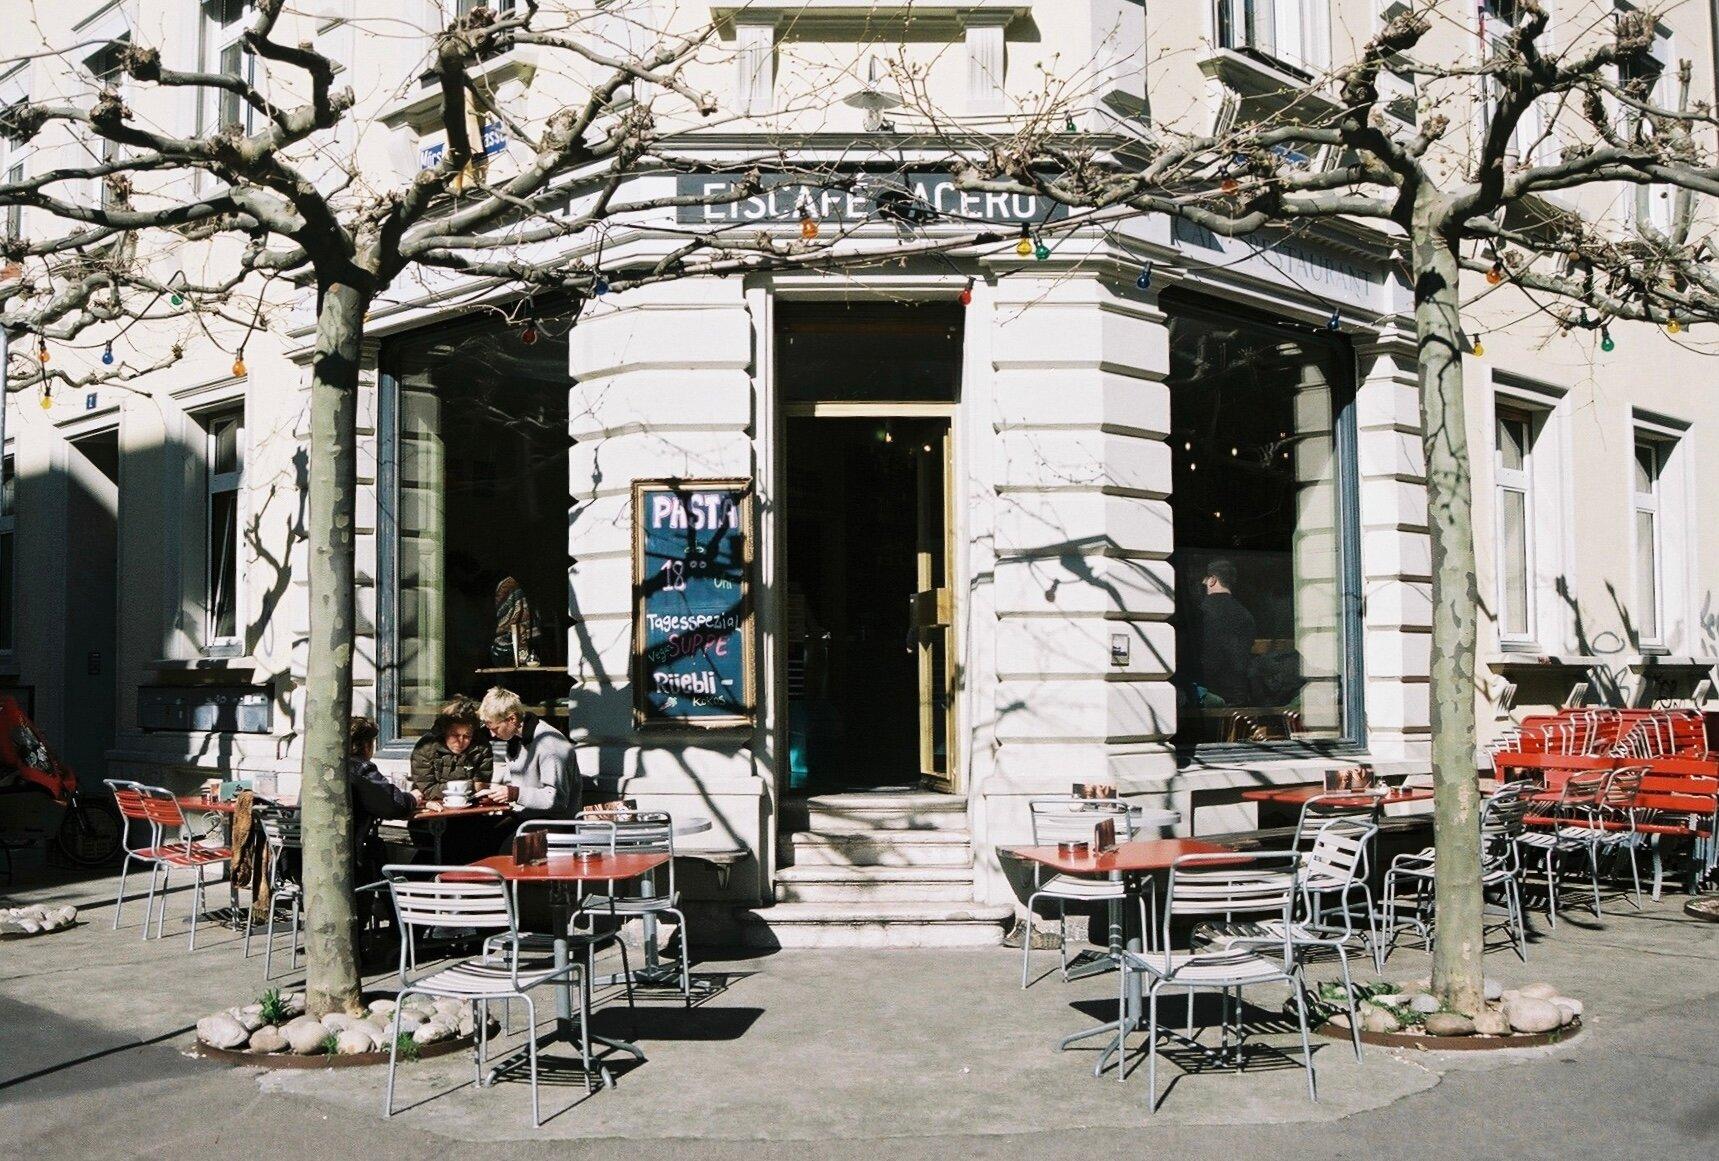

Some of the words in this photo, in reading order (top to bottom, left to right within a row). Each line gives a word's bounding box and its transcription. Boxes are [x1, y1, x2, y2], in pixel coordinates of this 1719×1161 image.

[652, 493, 738, 530] PASTA
[646, 612, 742, 632] Tagesspezial
[669, 633, 730, 658] SUPPE
